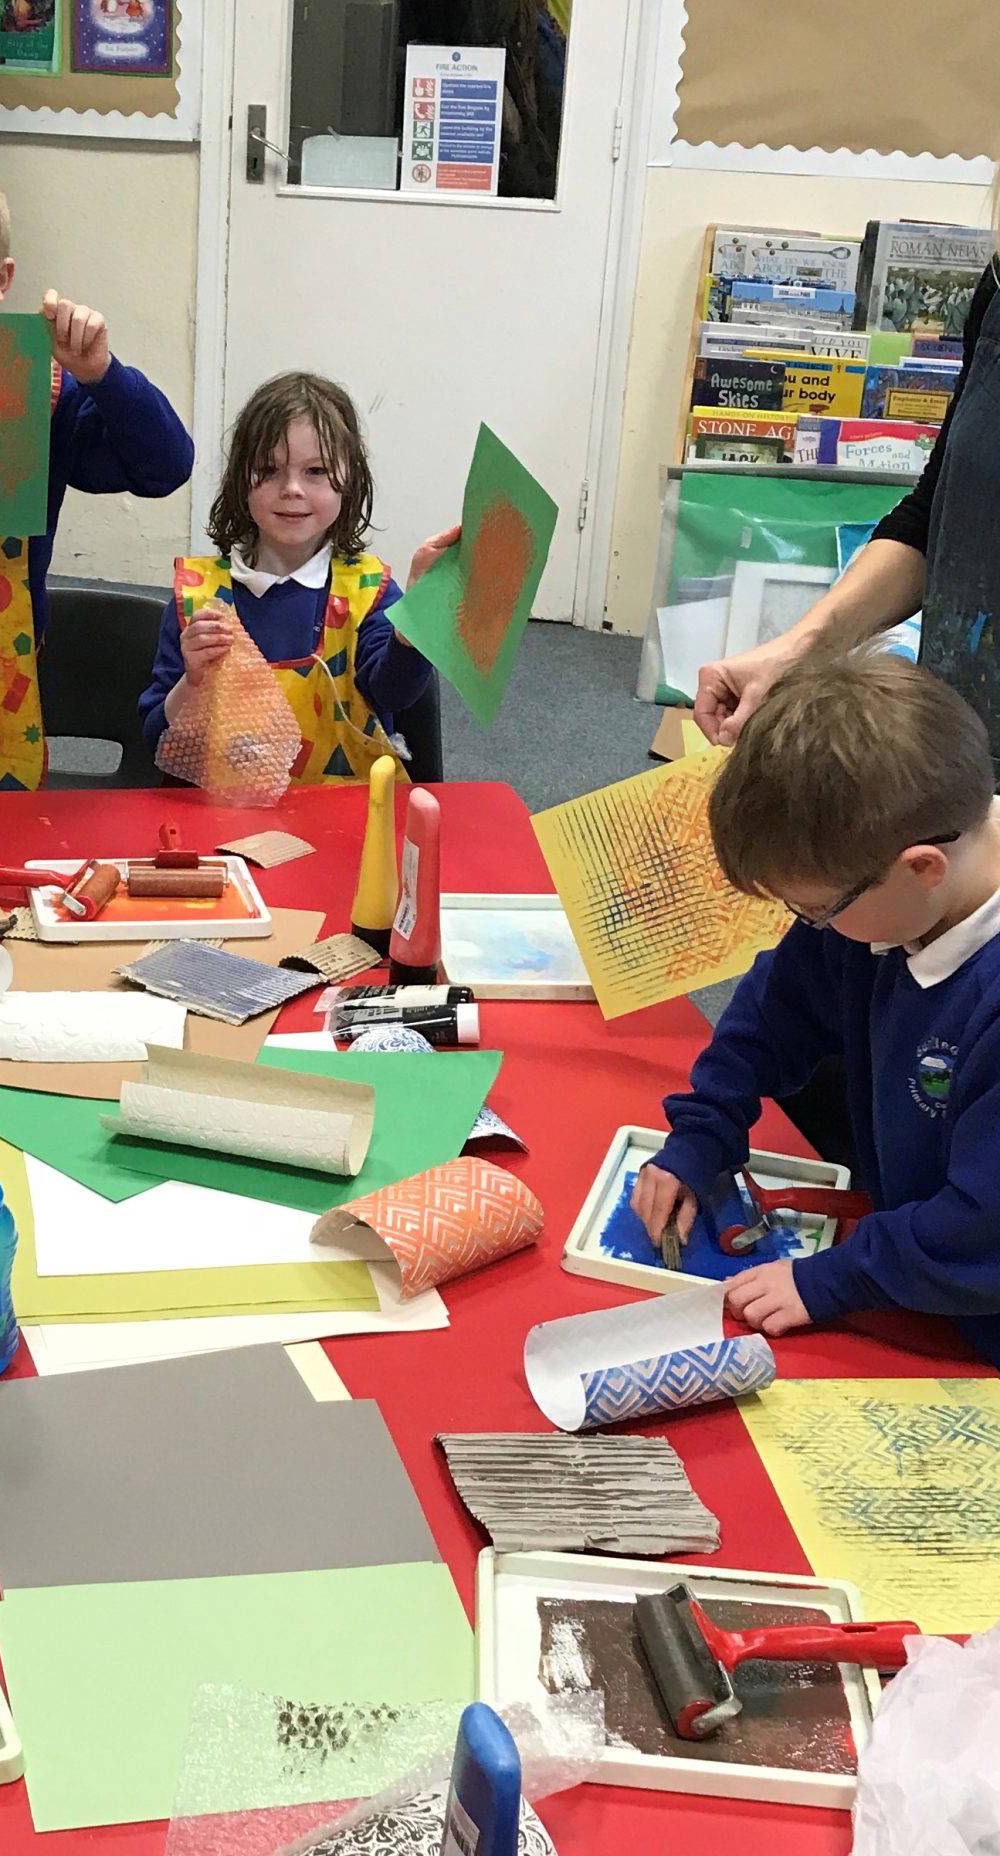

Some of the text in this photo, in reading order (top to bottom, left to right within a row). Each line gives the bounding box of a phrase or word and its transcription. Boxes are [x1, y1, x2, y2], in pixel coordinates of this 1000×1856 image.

[452, 64, 478, 72] ACTION
[890, 240, 986, 258] ROMAN NEWS
[754, 263, 847, 278] ABOUT THE
[711, 373, 772, 392] Awesome
[801, 375, 830, 386] and
[718, 390, 759, 408] Skies
[799, 388, 836, 404] body
[697, 420, 797, 440] STONE AG
[845, 443, 893, 459] Forces
[892, 449, 911, 460] and
